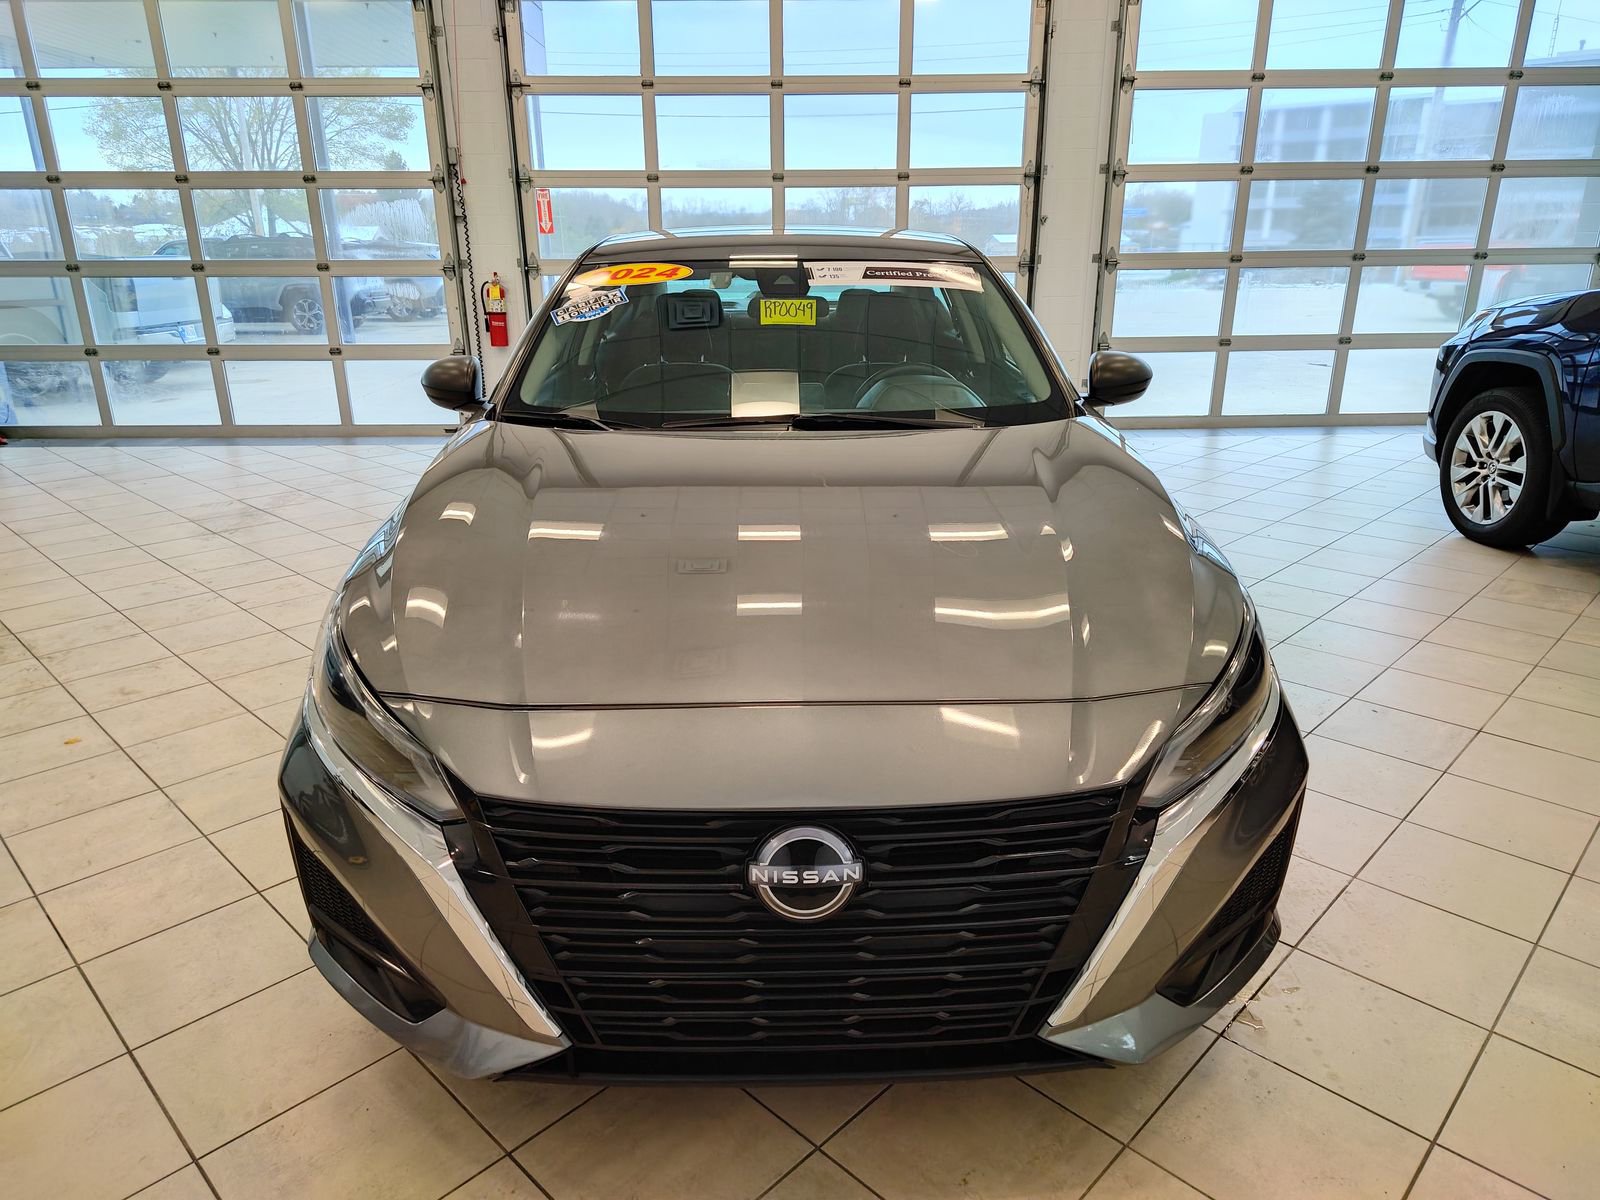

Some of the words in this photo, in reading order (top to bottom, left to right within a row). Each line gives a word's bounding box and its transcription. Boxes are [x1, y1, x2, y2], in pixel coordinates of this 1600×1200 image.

[538, 192, 549, 200] FIRE
[556, 292, 621, 317] CARFAX
[570, 297, 624, 318] OWNER
[764, 301, 813, 320] RP0049
[752, 866, 860, 884] NISSAN
